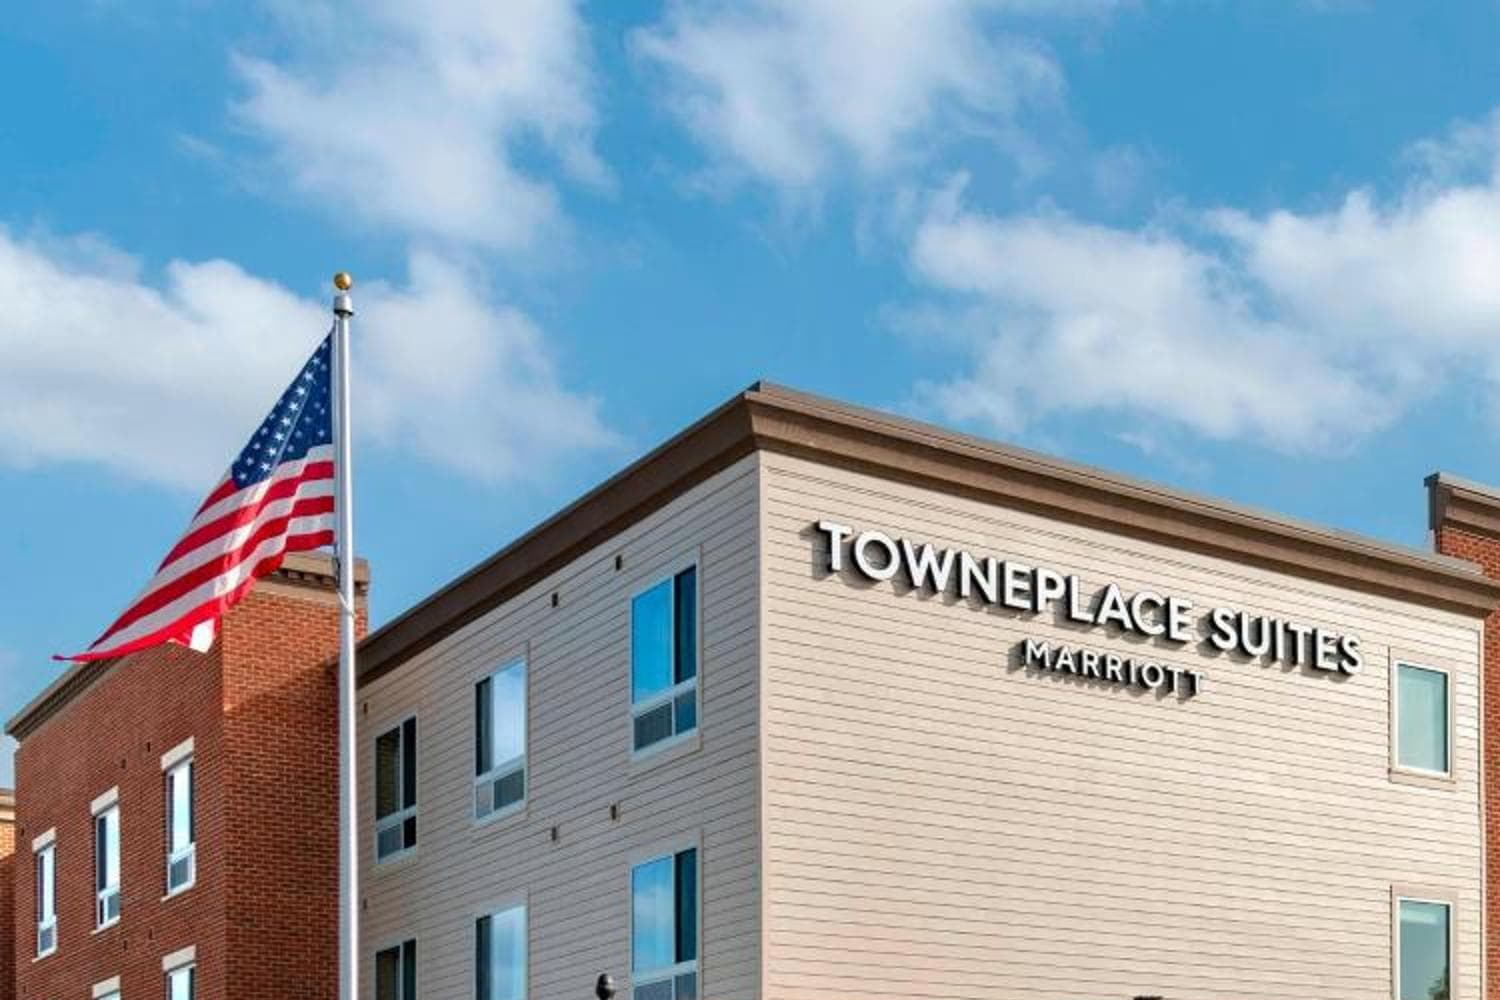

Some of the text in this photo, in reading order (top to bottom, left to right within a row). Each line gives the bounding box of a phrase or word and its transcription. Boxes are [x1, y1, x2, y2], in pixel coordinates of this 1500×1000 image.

[817, 520, 1364, 675] TOWNEPLACE SUITES
[1023, 638, 1205, 697] MARRIOTT
